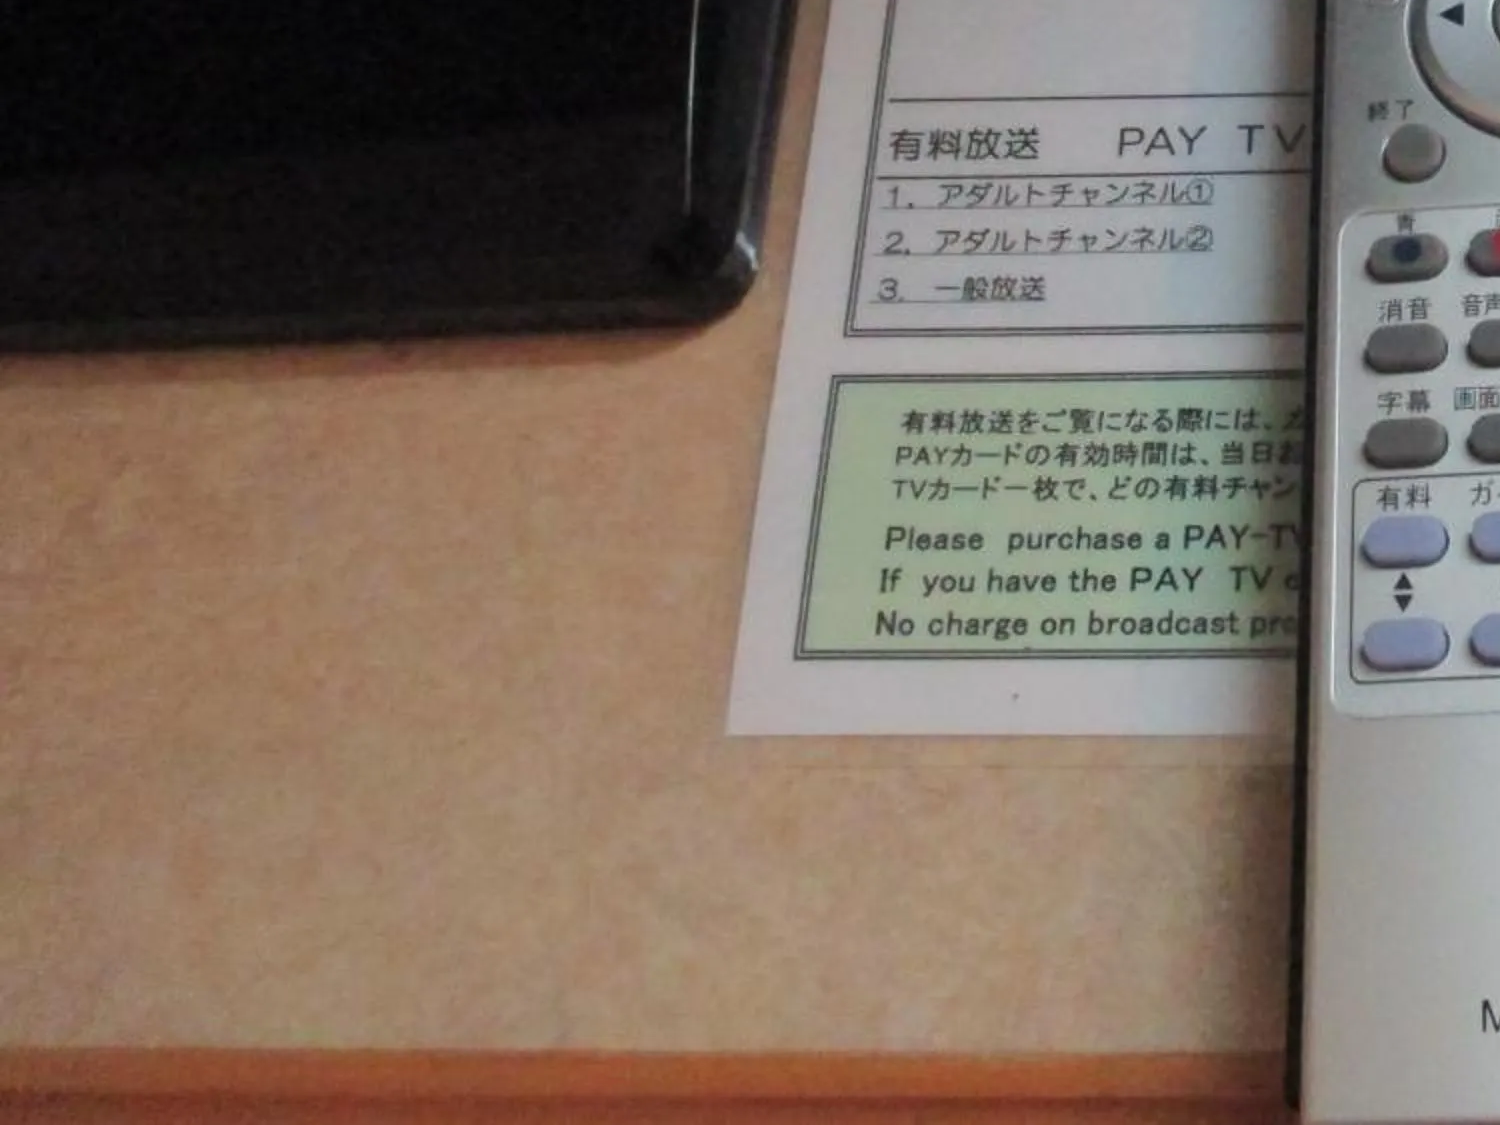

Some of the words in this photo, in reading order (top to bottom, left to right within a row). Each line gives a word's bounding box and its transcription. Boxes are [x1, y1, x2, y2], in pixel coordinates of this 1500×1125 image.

[1367, 100, 1414, 121] 終了
[890, 127, 1040, 162] 有料放送
[1118, 125, 1207, 156] PAY
[1237, 124, 1307, 154] TV
[938, 179, 1215, 207] アダルトチャンネル①
[935, 225, 1214, 253] アダルトチャンネル②
[934, 276, 1046, 302] 一般放送
[1378, 297, 1432, 323] 消音
[1377, 390, 1431, 414] 字幕
[1376, 482, 1433, 510] 有料
[885, 526, 984, 552] Please
[1007, 525, 1142, 555] purchase
[1154, 532, 1170, 551] a
[879, 568, 902, 594] If
[922, 573, 976, 597] you
[987, 567, 1056, 593] have
[1068, 567, 1117, 592] the
[1130, 567, 1204, 592] PAY
[1230, 567, 1273, 592] TV
[874, 611, 915, 637] No
[927, 610, 1028, 642] charge
[1040, 615, 1076, 637] on
[1088, 609, 1239, 637] broadcast
